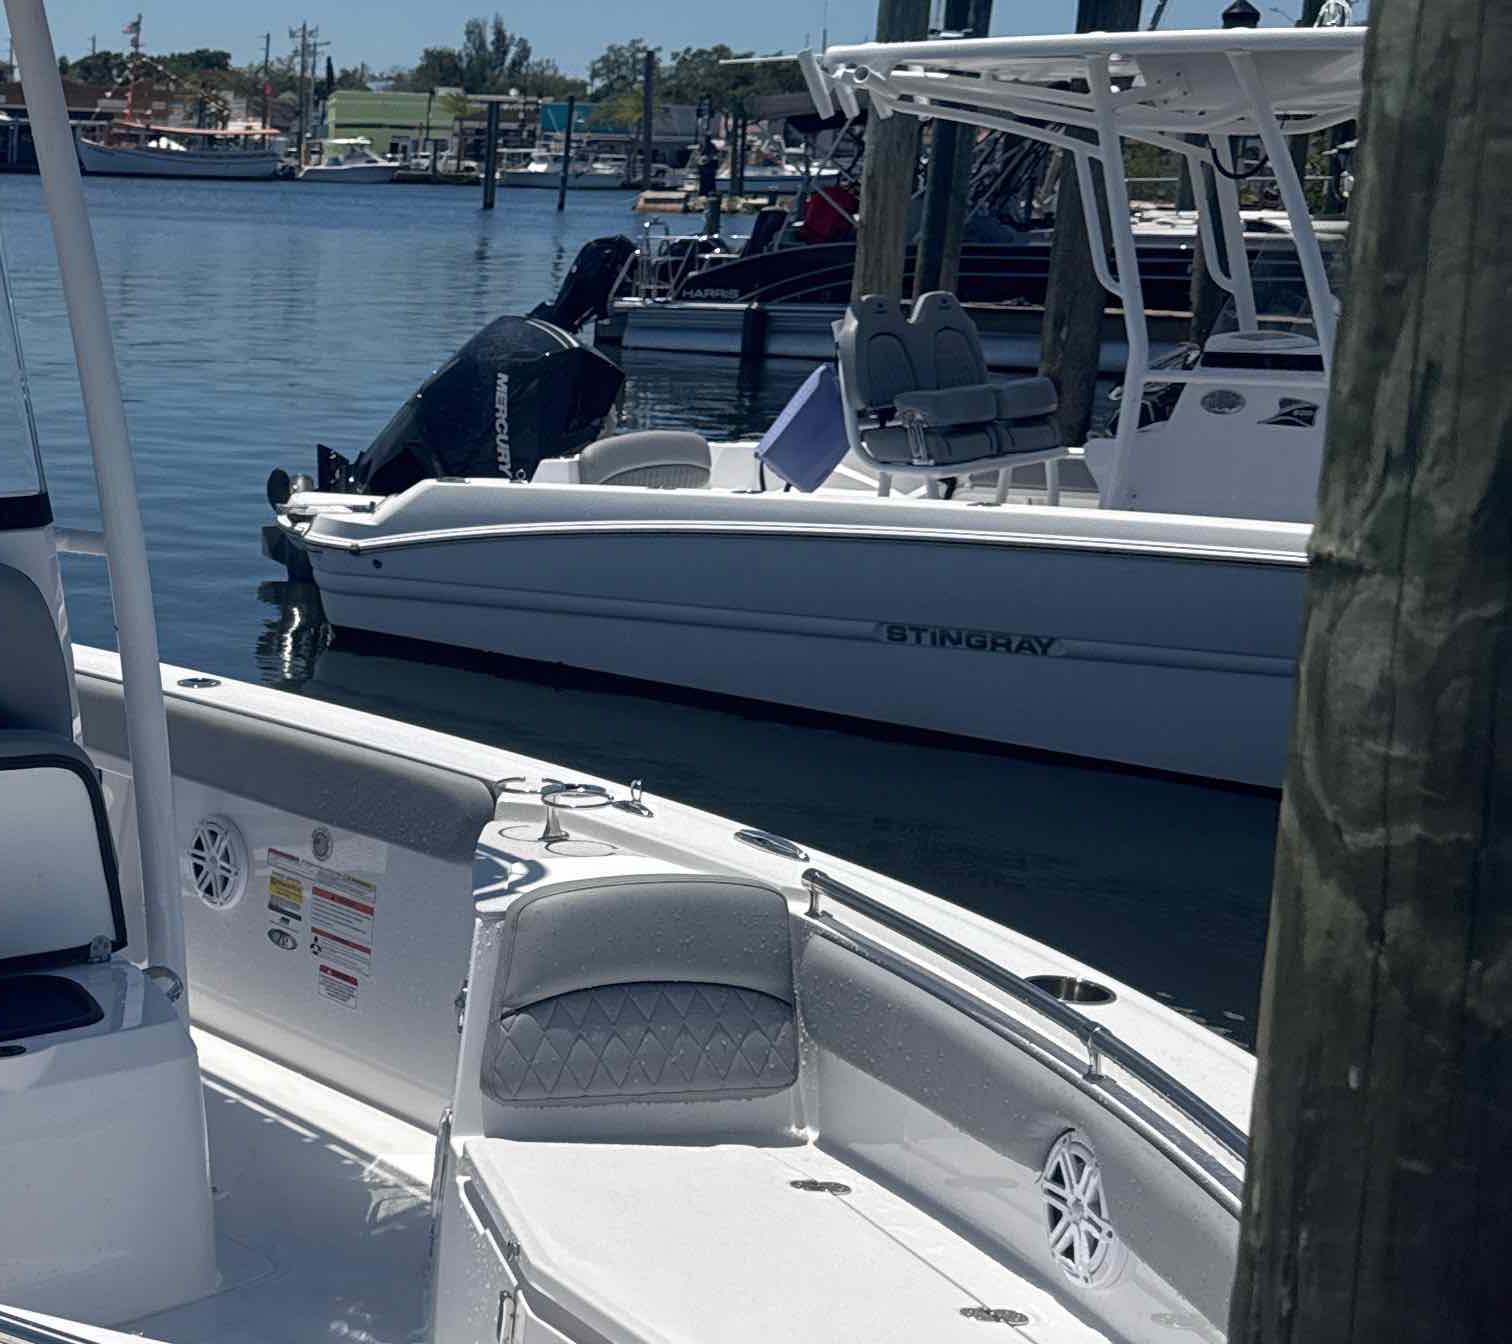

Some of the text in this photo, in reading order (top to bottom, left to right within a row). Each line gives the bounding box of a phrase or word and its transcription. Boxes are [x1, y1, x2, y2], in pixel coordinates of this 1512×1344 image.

[682, 288, 740, 299] HARRIS
[494, 371, 513, 478] MERCURY
[886, 624, 1058, 656] STINGRAY
